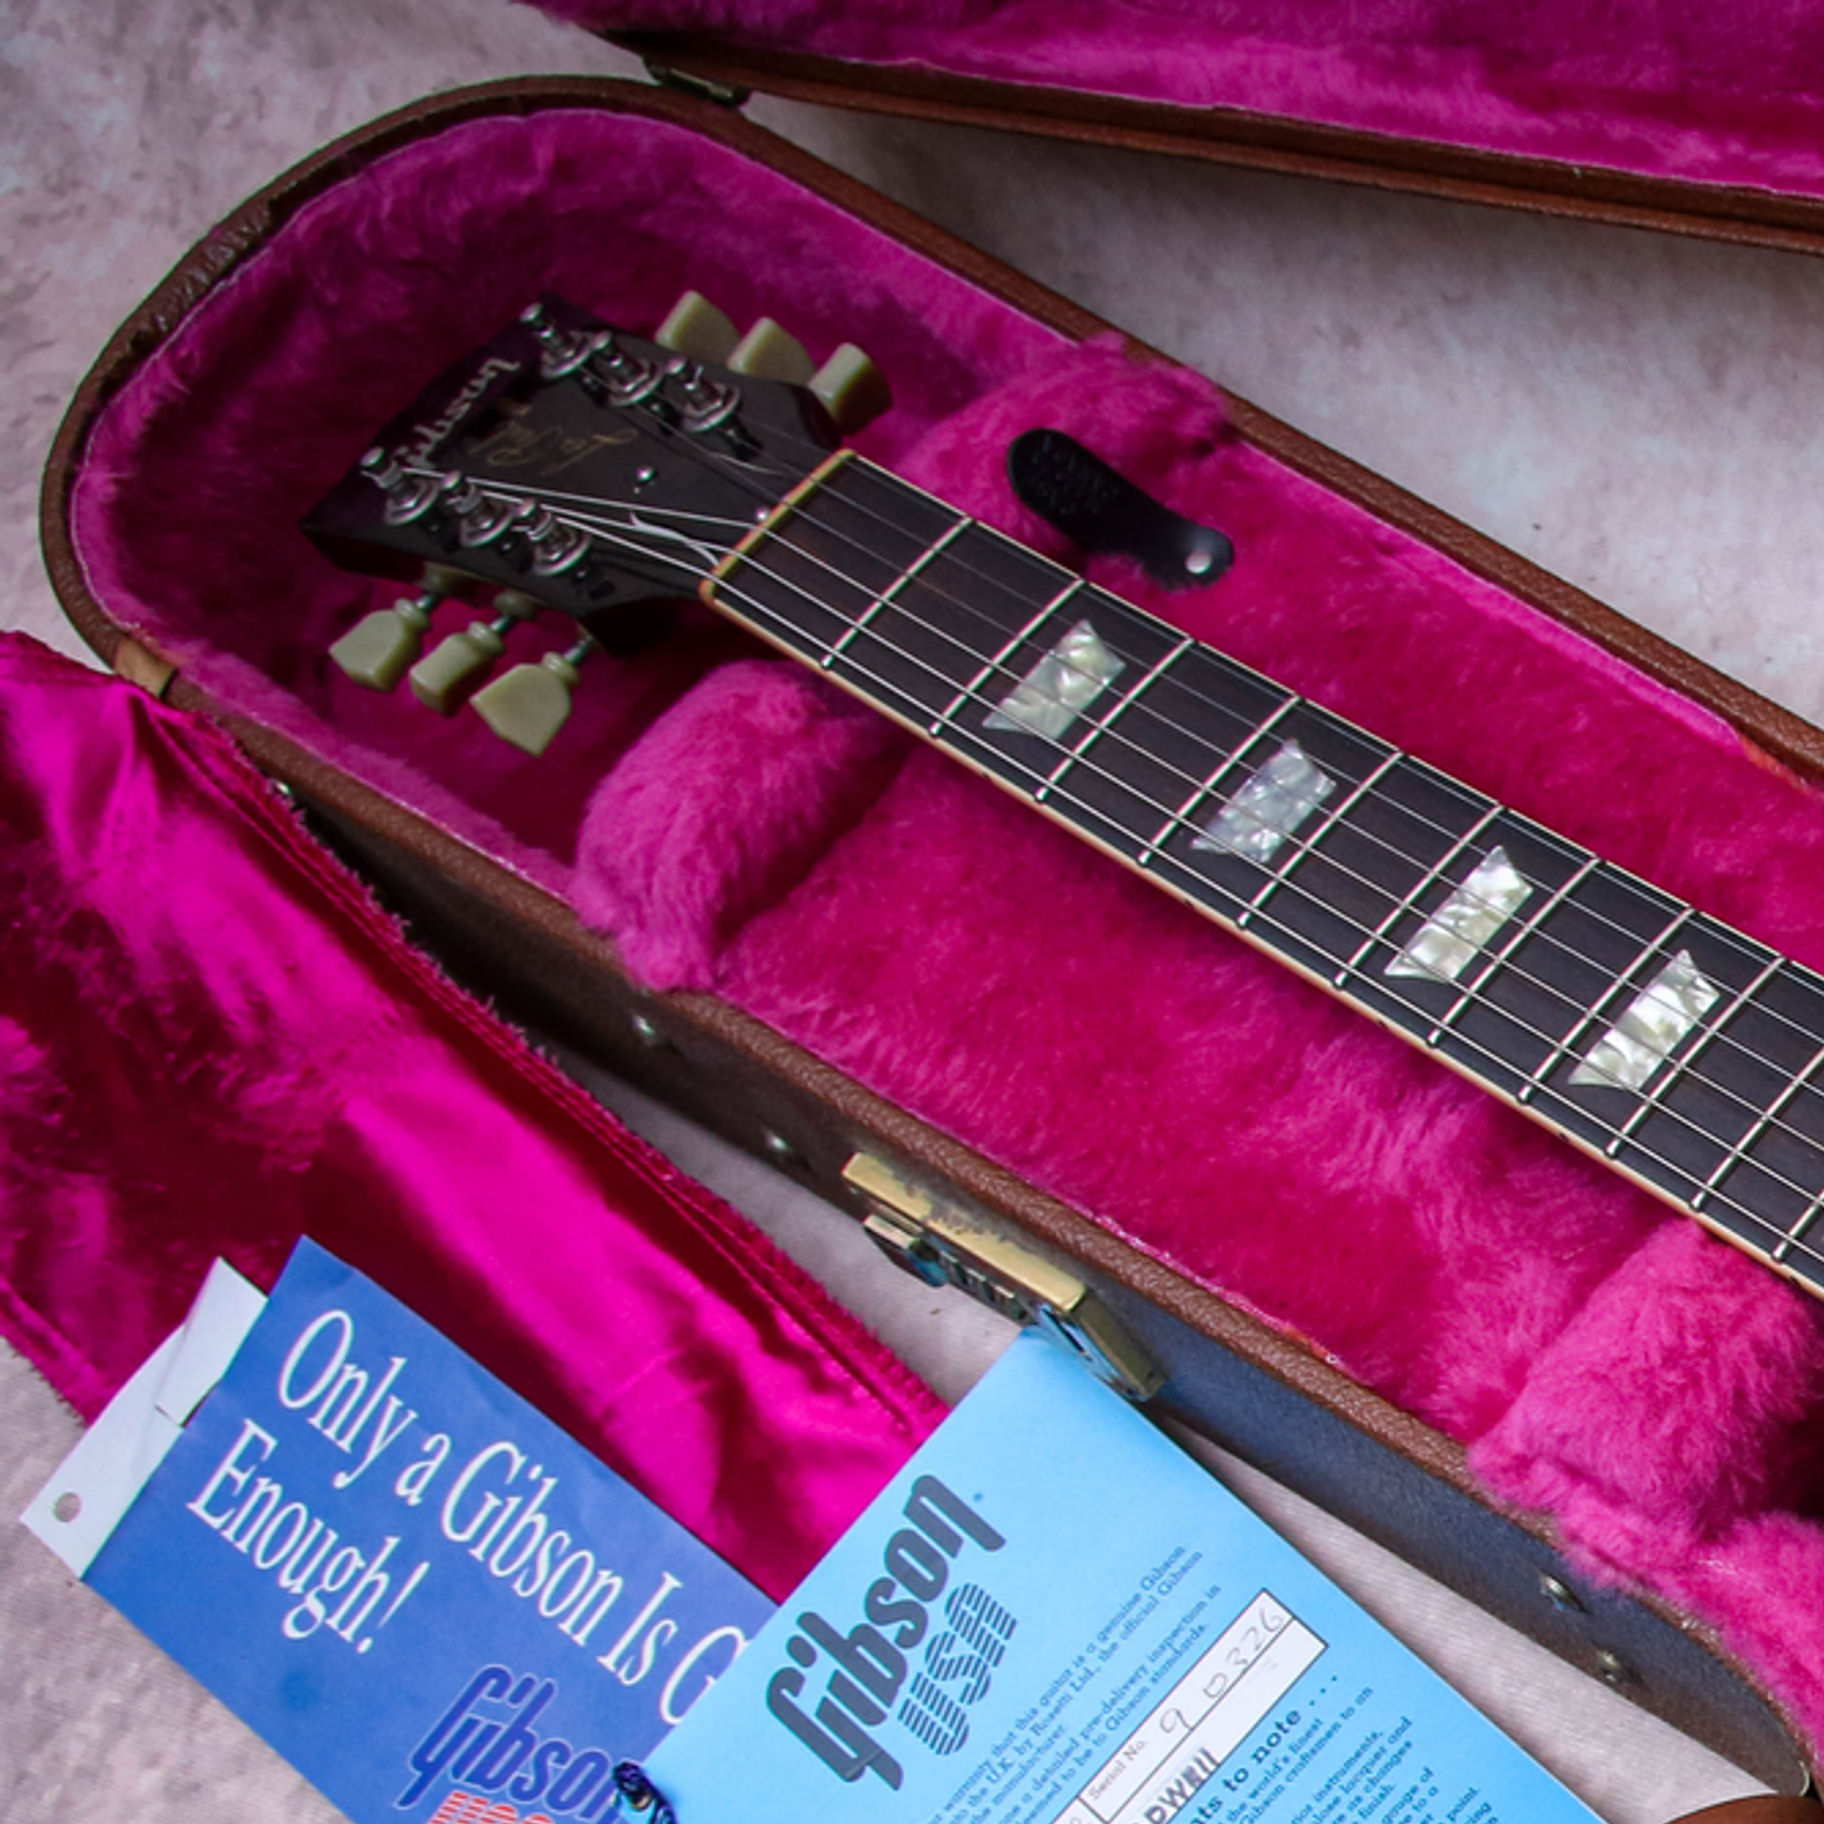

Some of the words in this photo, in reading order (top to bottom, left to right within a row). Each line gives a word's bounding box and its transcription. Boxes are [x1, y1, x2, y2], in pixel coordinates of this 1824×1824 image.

[189, 1418, 430, 1656] Enough!
[278, 1309, 419, 1490] Only
[395, 1433, 452, 1506] a
[442, 1440, 624, 1648] Gibson
[597, 1571, 683, 1687] Is
[765, 1473, 1007, 1792] Gibson
[897, 1582, 1018, 1757] USA
[990, 1730, 1018, 1758] that
[1013, 1706, 1039, 1731] this
[1038, 1667, 1074, 1708] guitar
[1070, 1654, 1087, 1669] is
[1084, 1641, 1099, 1655] a
[1138, 1545, 1186, 1592] Gibson
[1087, 1758, 1127, 1801] Serial
[1221, 1766, 1249, 1792] to
[1249, 1709, 1301, 1765] note
[1337, 1744, 1388, 1795] lacquer
[1386, 1714, 1413, 1745] and
[1345, 1793, 1364, 1813] as
[1362, 1739, 1413, 1794] changes
